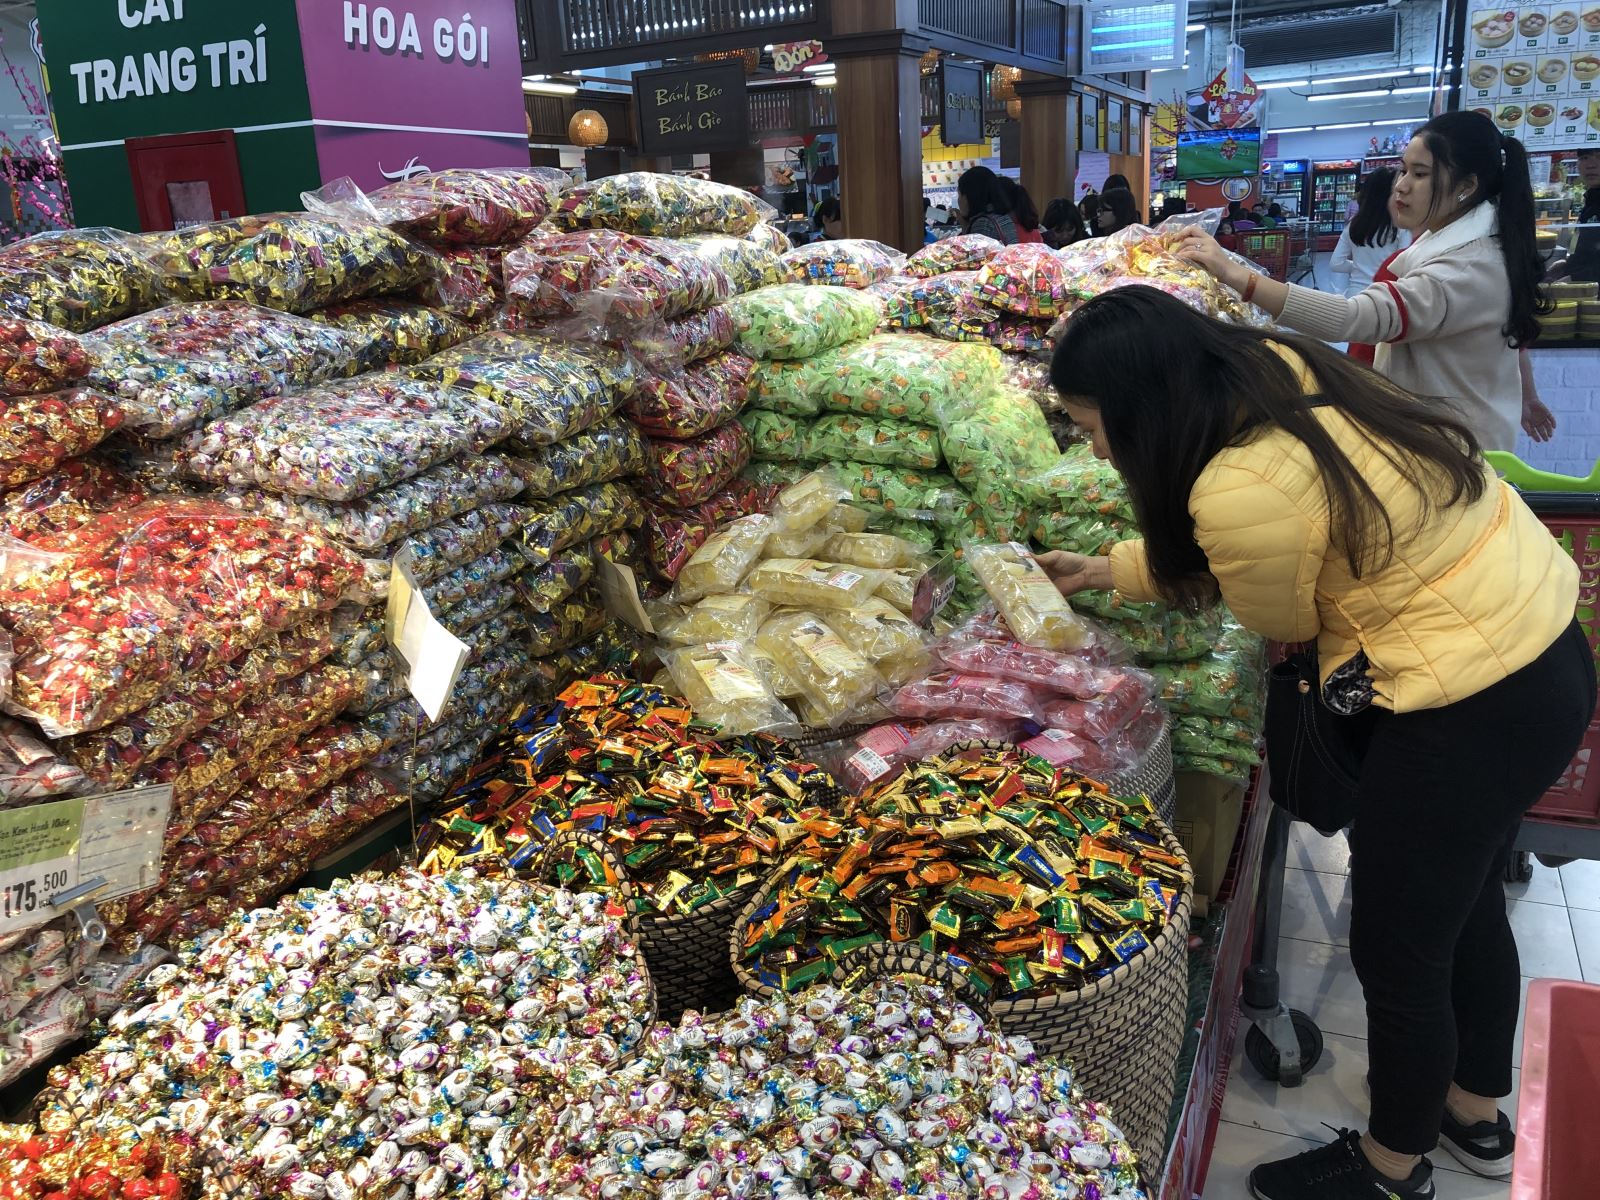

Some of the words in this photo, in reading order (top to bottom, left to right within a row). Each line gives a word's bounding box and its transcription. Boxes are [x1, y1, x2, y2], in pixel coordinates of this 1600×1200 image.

[343, 1, 424, 54] HOA
[432, 12, 490, 63] GÓI
[69, 46, 198, 105] TRANG
[202, 24, 268, 88] TRÍ
[654, 81, 690, 106] Bánh
[695, 84, 723, 101] Bao
[657, 112, 693, 135] Bánh
